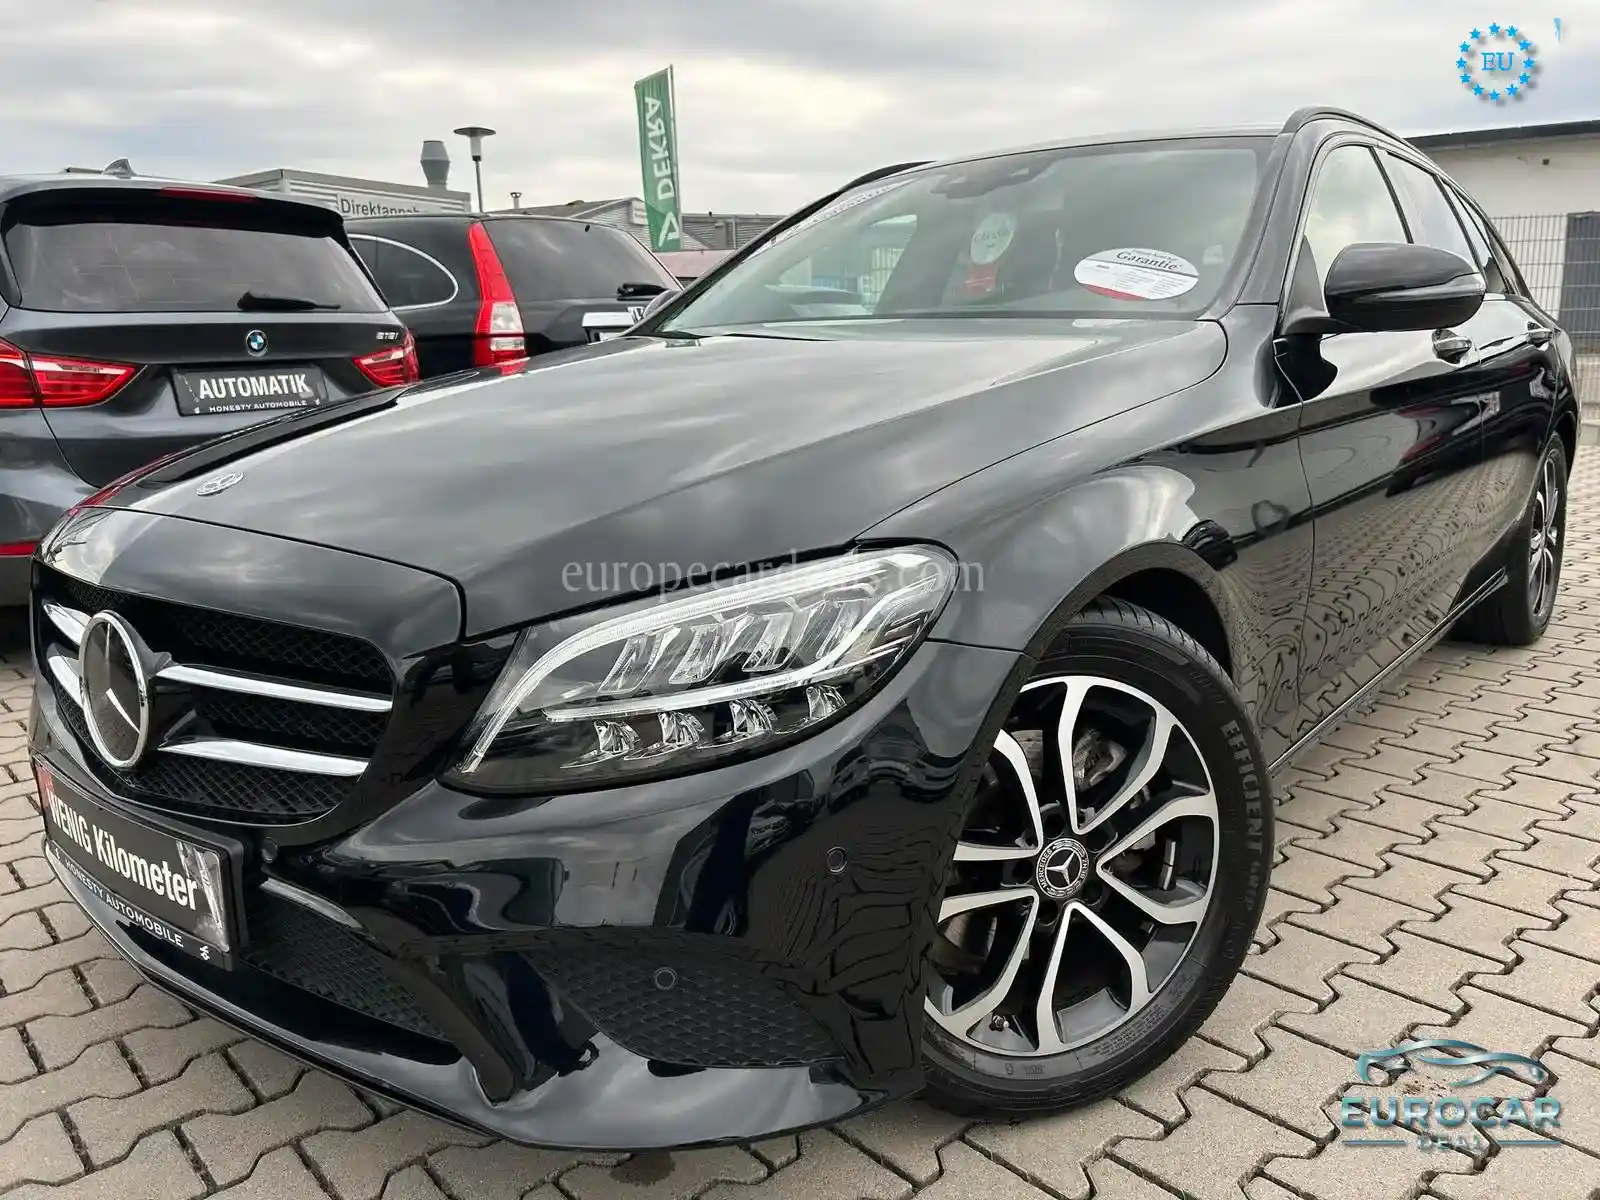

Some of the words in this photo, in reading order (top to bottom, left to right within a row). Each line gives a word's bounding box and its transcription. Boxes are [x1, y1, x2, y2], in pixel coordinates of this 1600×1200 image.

[644, 96, 675, 201] DEKRA
[199, 373, 312, 399] AUTOMATIK
[209, 403, 251, 413] HONESTY
[253, 400, 308, 409] AUTOMOBILE
[1220, 719, 1262, 854] EFFICIENT
[47, 788, 93, 856] WENIG
[93, 823, 198, 911] Kilometer
[1038, 848, 1053, 889] MERCEDES
[65, 858, 104, 898] HONESTY
[106, 894, 184, 948] AUTOMOBILE
